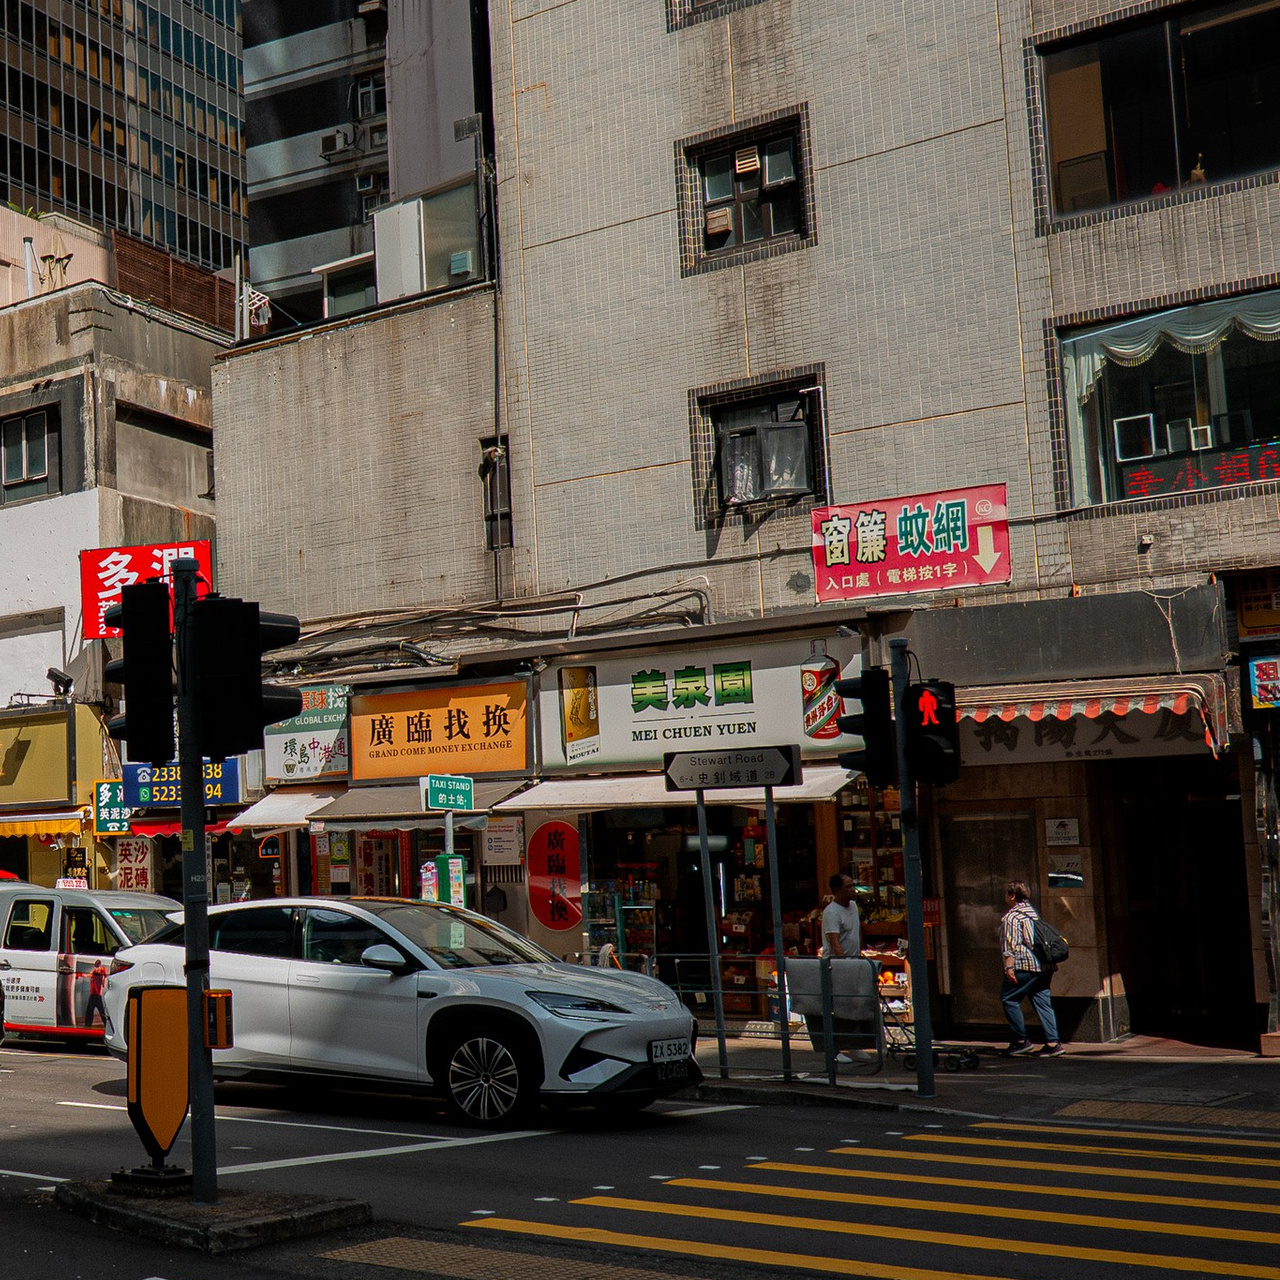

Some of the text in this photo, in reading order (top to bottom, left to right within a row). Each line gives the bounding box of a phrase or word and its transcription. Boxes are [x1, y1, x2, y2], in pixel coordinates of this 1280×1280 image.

[821, 498, 969, 568] 窗簾 蚊網
[826, 573, 870, 590] 入口處
[631, 660, 755, 713] 美泉園
[301, 686, 347, 712] 環球找
[295, 714, 322, 726] GLOBAL
[632, 722, 757, 741] MEI CHUEN YUEN
[369, 739, 513, 759] GRAND COME MONEY EXCHANGE
[568, 747, 600, 762] MOUTAI
[690, 753, 764, 767] Stewart Road
[431, 779, 470, 791] TAXI STAND
[438, 793, 465, 805] 的士站
[653, 1042, 688, 1058] ZX 5382
